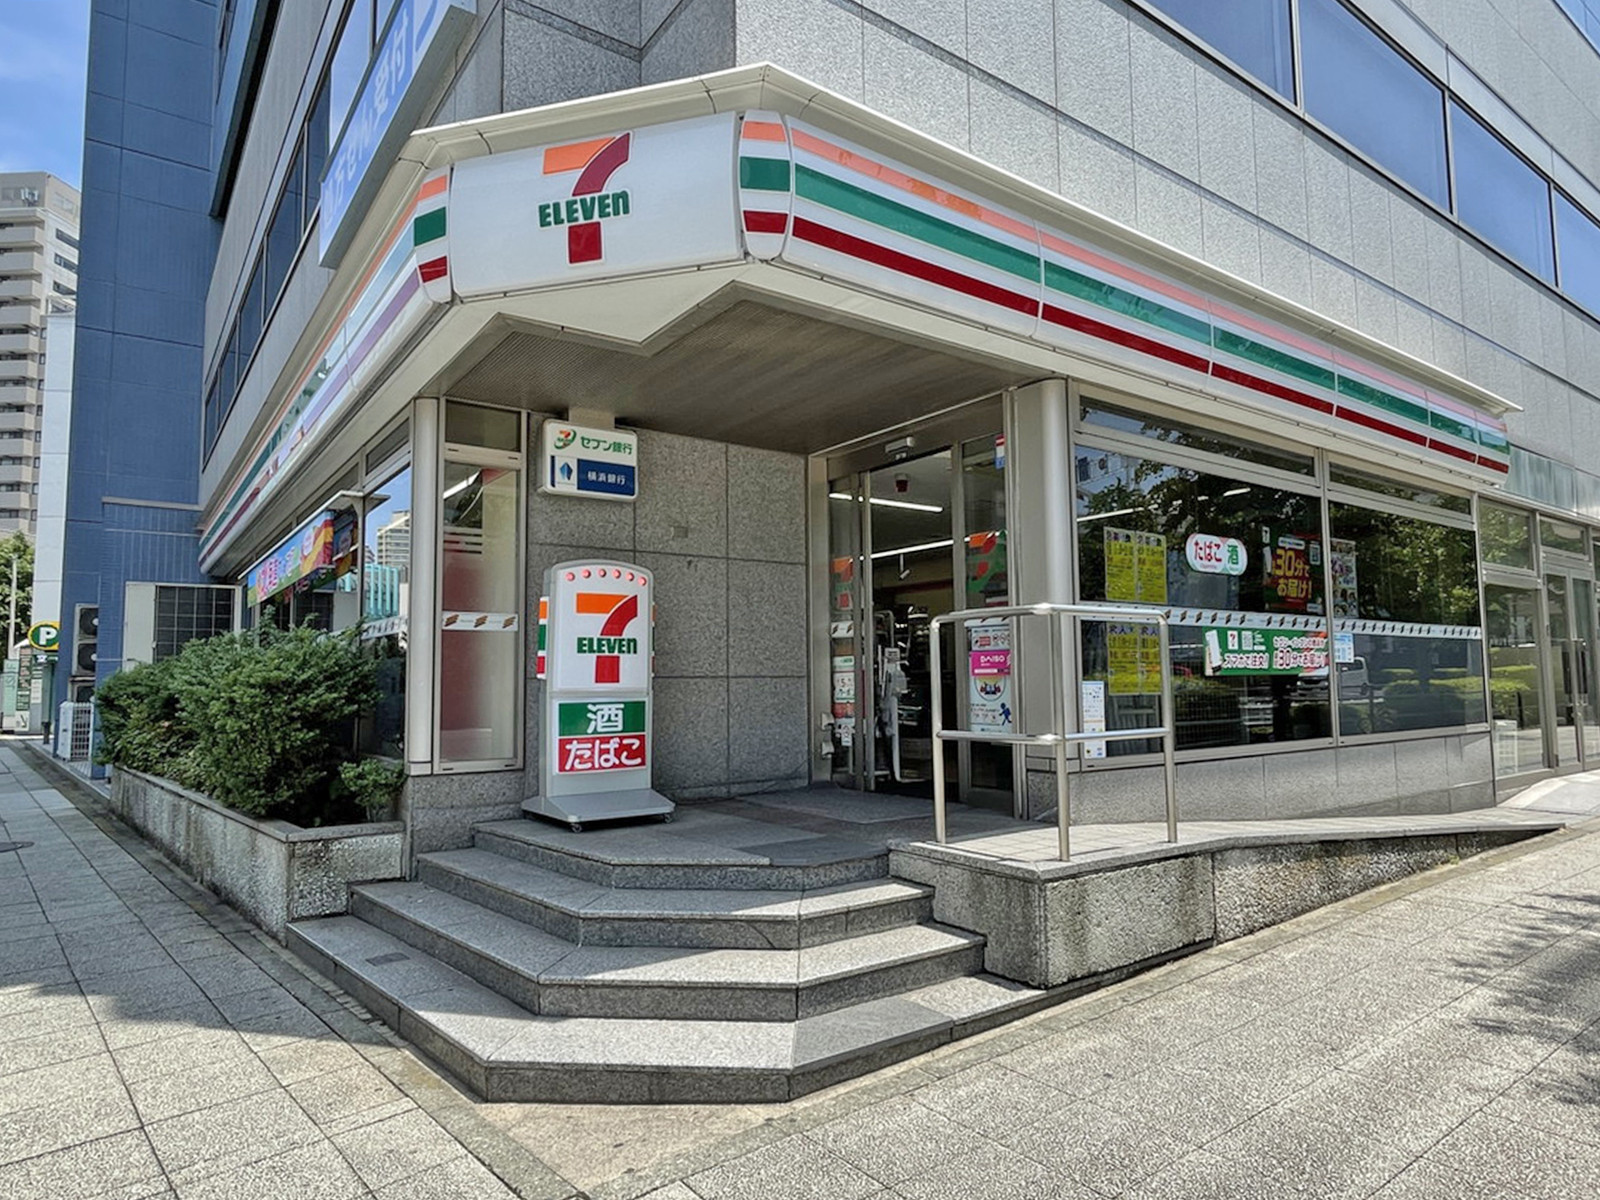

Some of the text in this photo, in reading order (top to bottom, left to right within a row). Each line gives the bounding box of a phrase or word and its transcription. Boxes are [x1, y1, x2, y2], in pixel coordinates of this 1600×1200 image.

[543, 132, 630, 264] 7
[580, 436, 633, 456] セブン銀行
[587, 470, 626, 485] 横浜銀行
[1194, 540, 1239, 565] たばこ 酒
[38, 626, 58, 646] P
[576, 592, 638, 683] 7
[587, 704, 624, 734] 酒
[565, 738, 642, 770] たばこ
